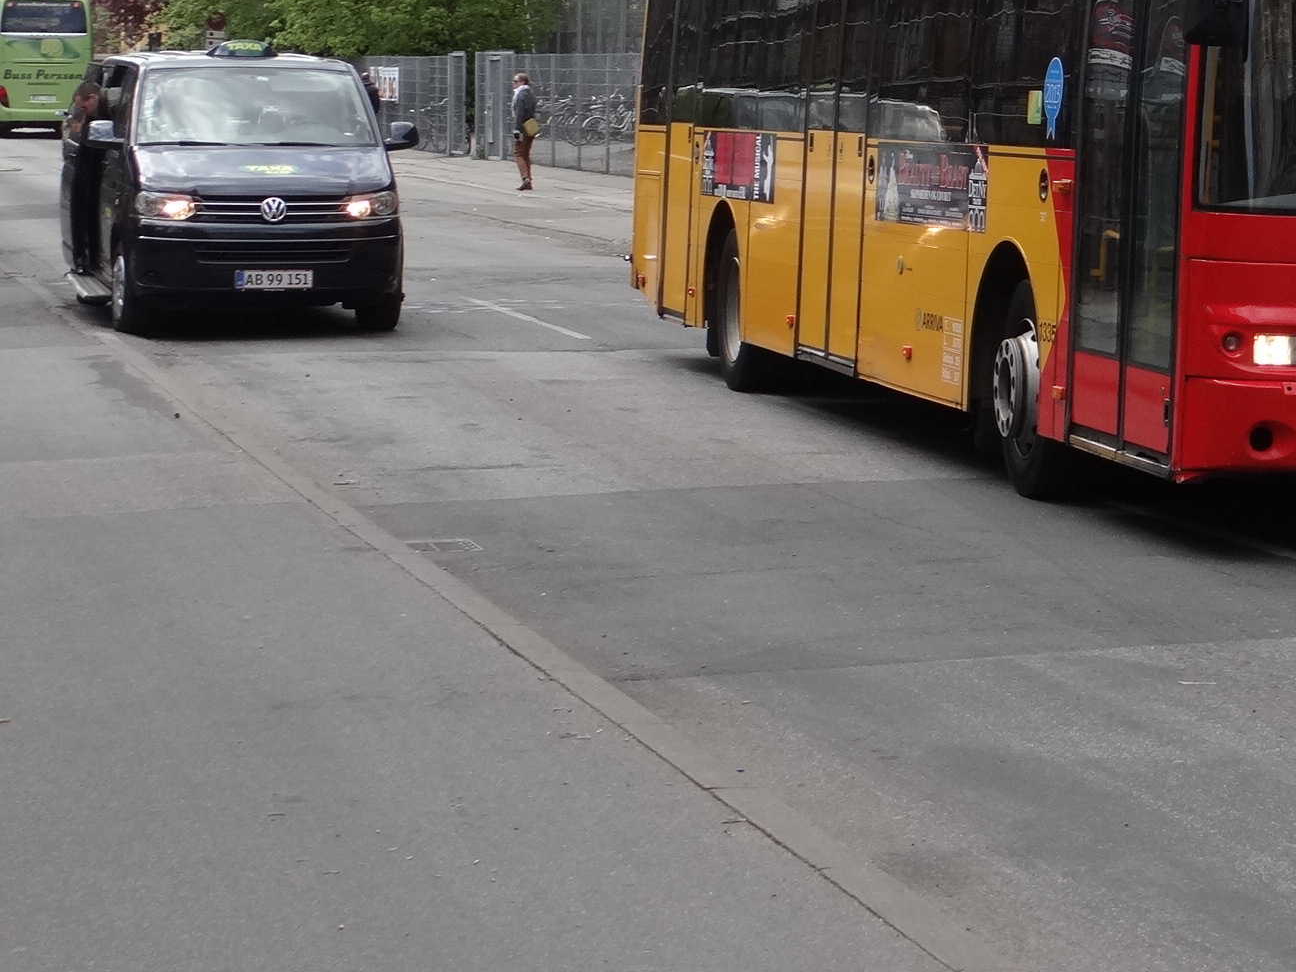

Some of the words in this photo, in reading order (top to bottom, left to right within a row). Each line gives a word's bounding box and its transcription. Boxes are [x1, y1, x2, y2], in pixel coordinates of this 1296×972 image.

[227, 41, 263, 52] TAXA
[3, 69, 32, 80] Buss
[35, 69, 84, 80] Persson
[754, 134, 762, 178] MUSICAL
[245, 273, 263, 286] AB
[266, 273, 283, 286] 99
[287, 273, 309, 286] 151
[921, 311, 943, 334] ARRIVA
[1038, 321, 1057, 343] 1335
